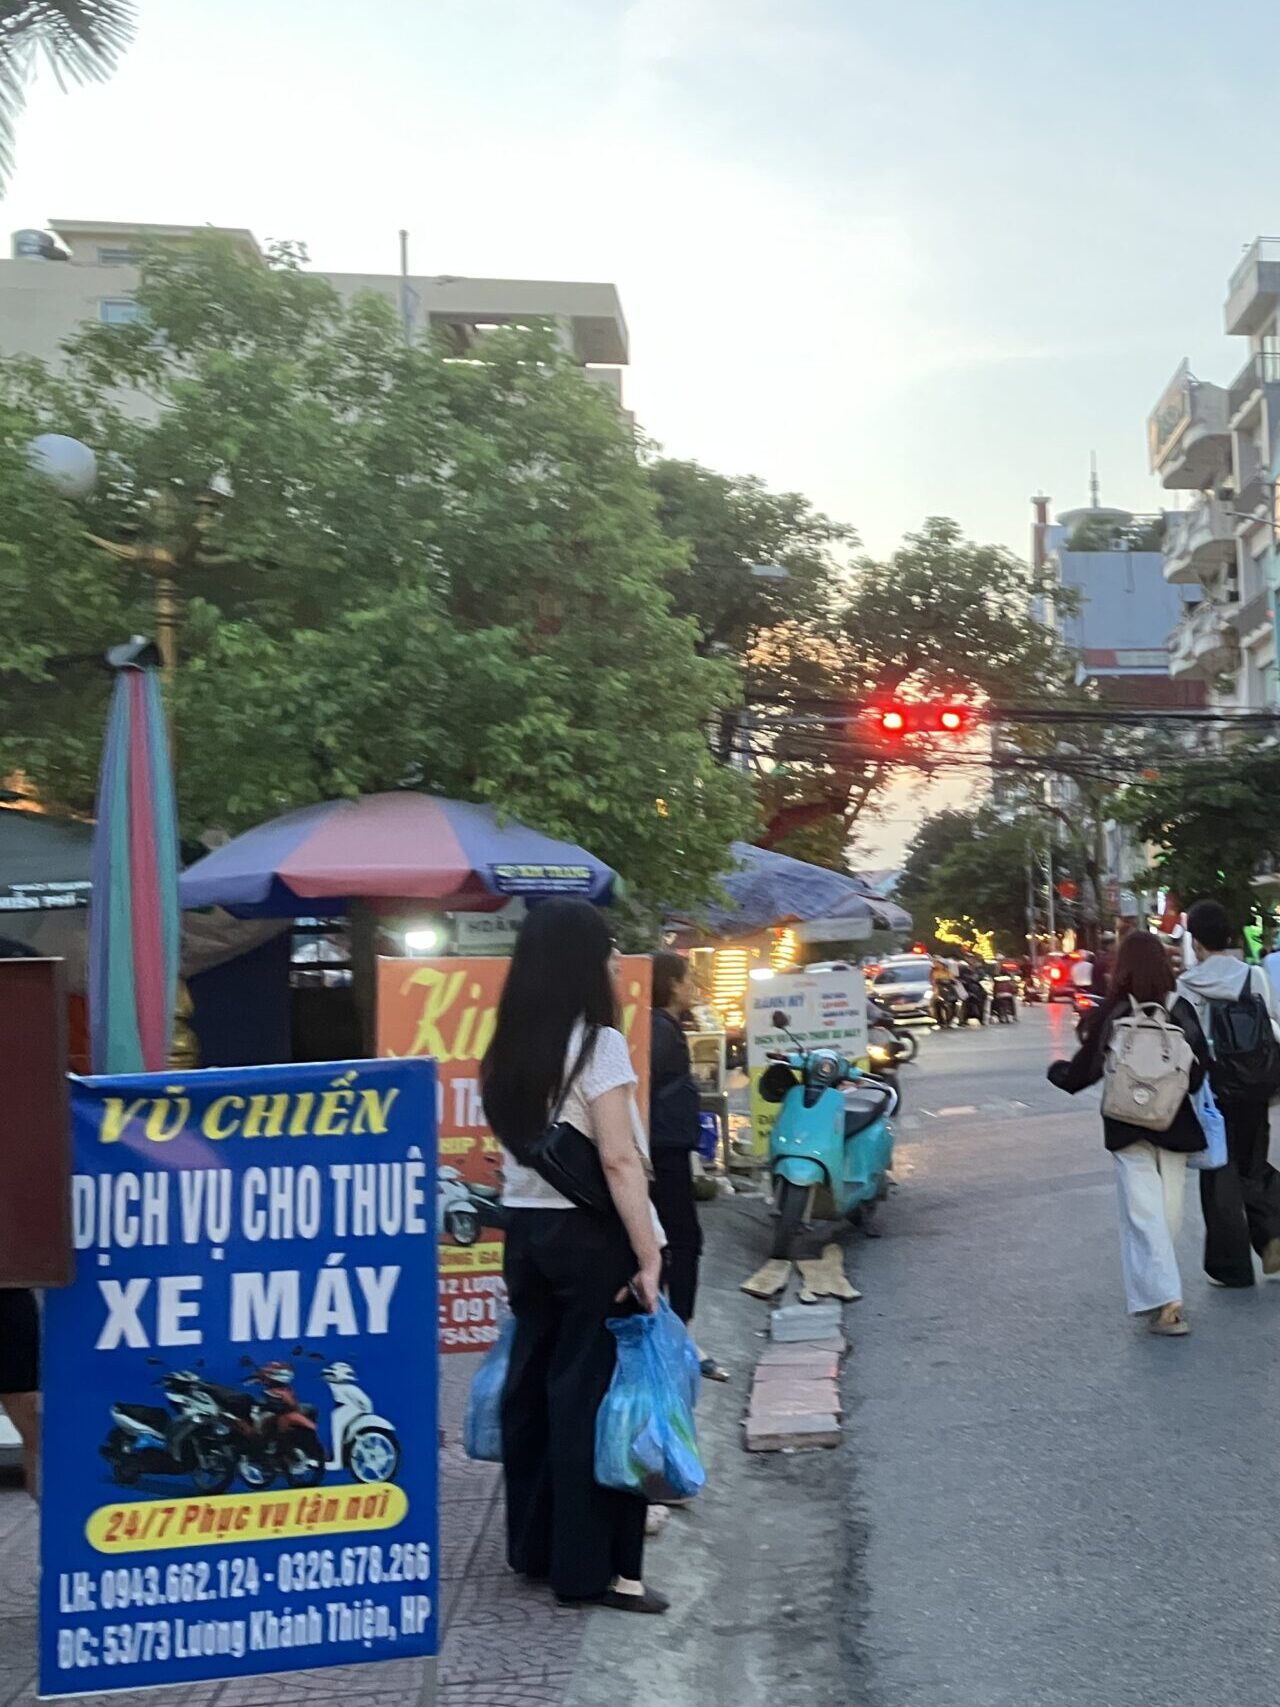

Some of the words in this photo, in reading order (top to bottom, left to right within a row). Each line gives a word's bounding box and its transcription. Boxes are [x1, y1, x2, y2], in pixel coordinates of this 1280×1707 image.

[98, 1085, 190, 1144] VŨ
[202, 1071, 399, 1141] CHIẾN
[72, 1171, 169, 1266] DỊCH
[180, 1169, 232, 1260] VỤ
[241, 1165, 321, 1242] CHO
[330, 1146, 427, 1237] THUÊ
[95, 1275, 203, 1350] XE
[230, 1252, 401, 1342] MÁY
[104, 1505, 175, 1543] 24/7
[179, 1504, 250, 1539] Phục
[258, 1503, 291, 1534] vụ
[295, 1493, 340, 1530] tận
[59, 1571, 97, 1613] LH:
[100, 1556, 260, 1610] 0943.662.124
[277, 1541, 431, 1593] 0326.678.266
[102, 1620, 171, 1666] 53/73
[249, 1605, 323, 1651] Khánh
[400, 1594, 433, 1636] HP
